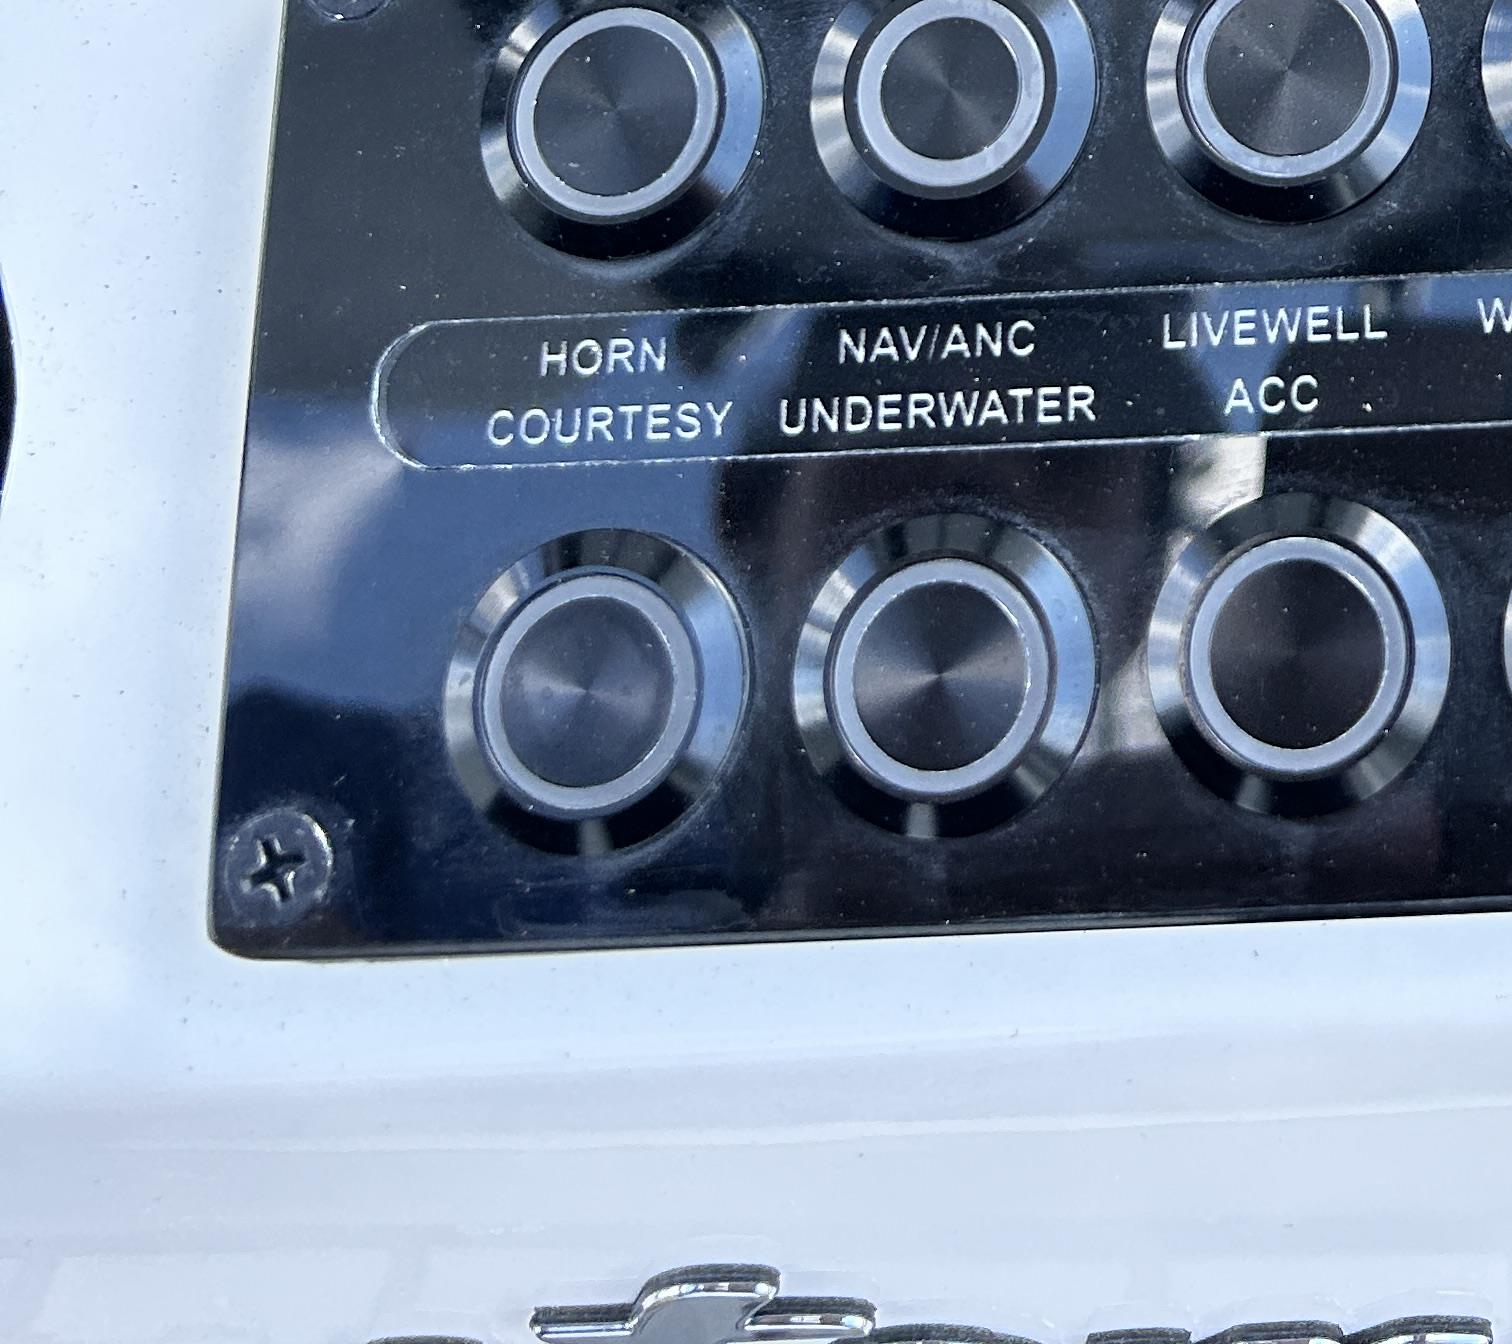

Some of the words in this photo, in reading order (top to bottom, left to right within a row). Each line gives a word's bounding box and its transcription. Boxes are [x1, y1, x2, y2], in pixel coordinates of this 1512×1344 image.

[839, 319, 1035, 364] NAV/ANC
[1162, 303, 1388, 350] LIVEWELL
[540, 336, 667, 377] HORN
[779, 385, 1096, 436] UNDERWATER
[1224, 374, 1319, 415] ACC
[487, 401, 733, 447] COURTESY
